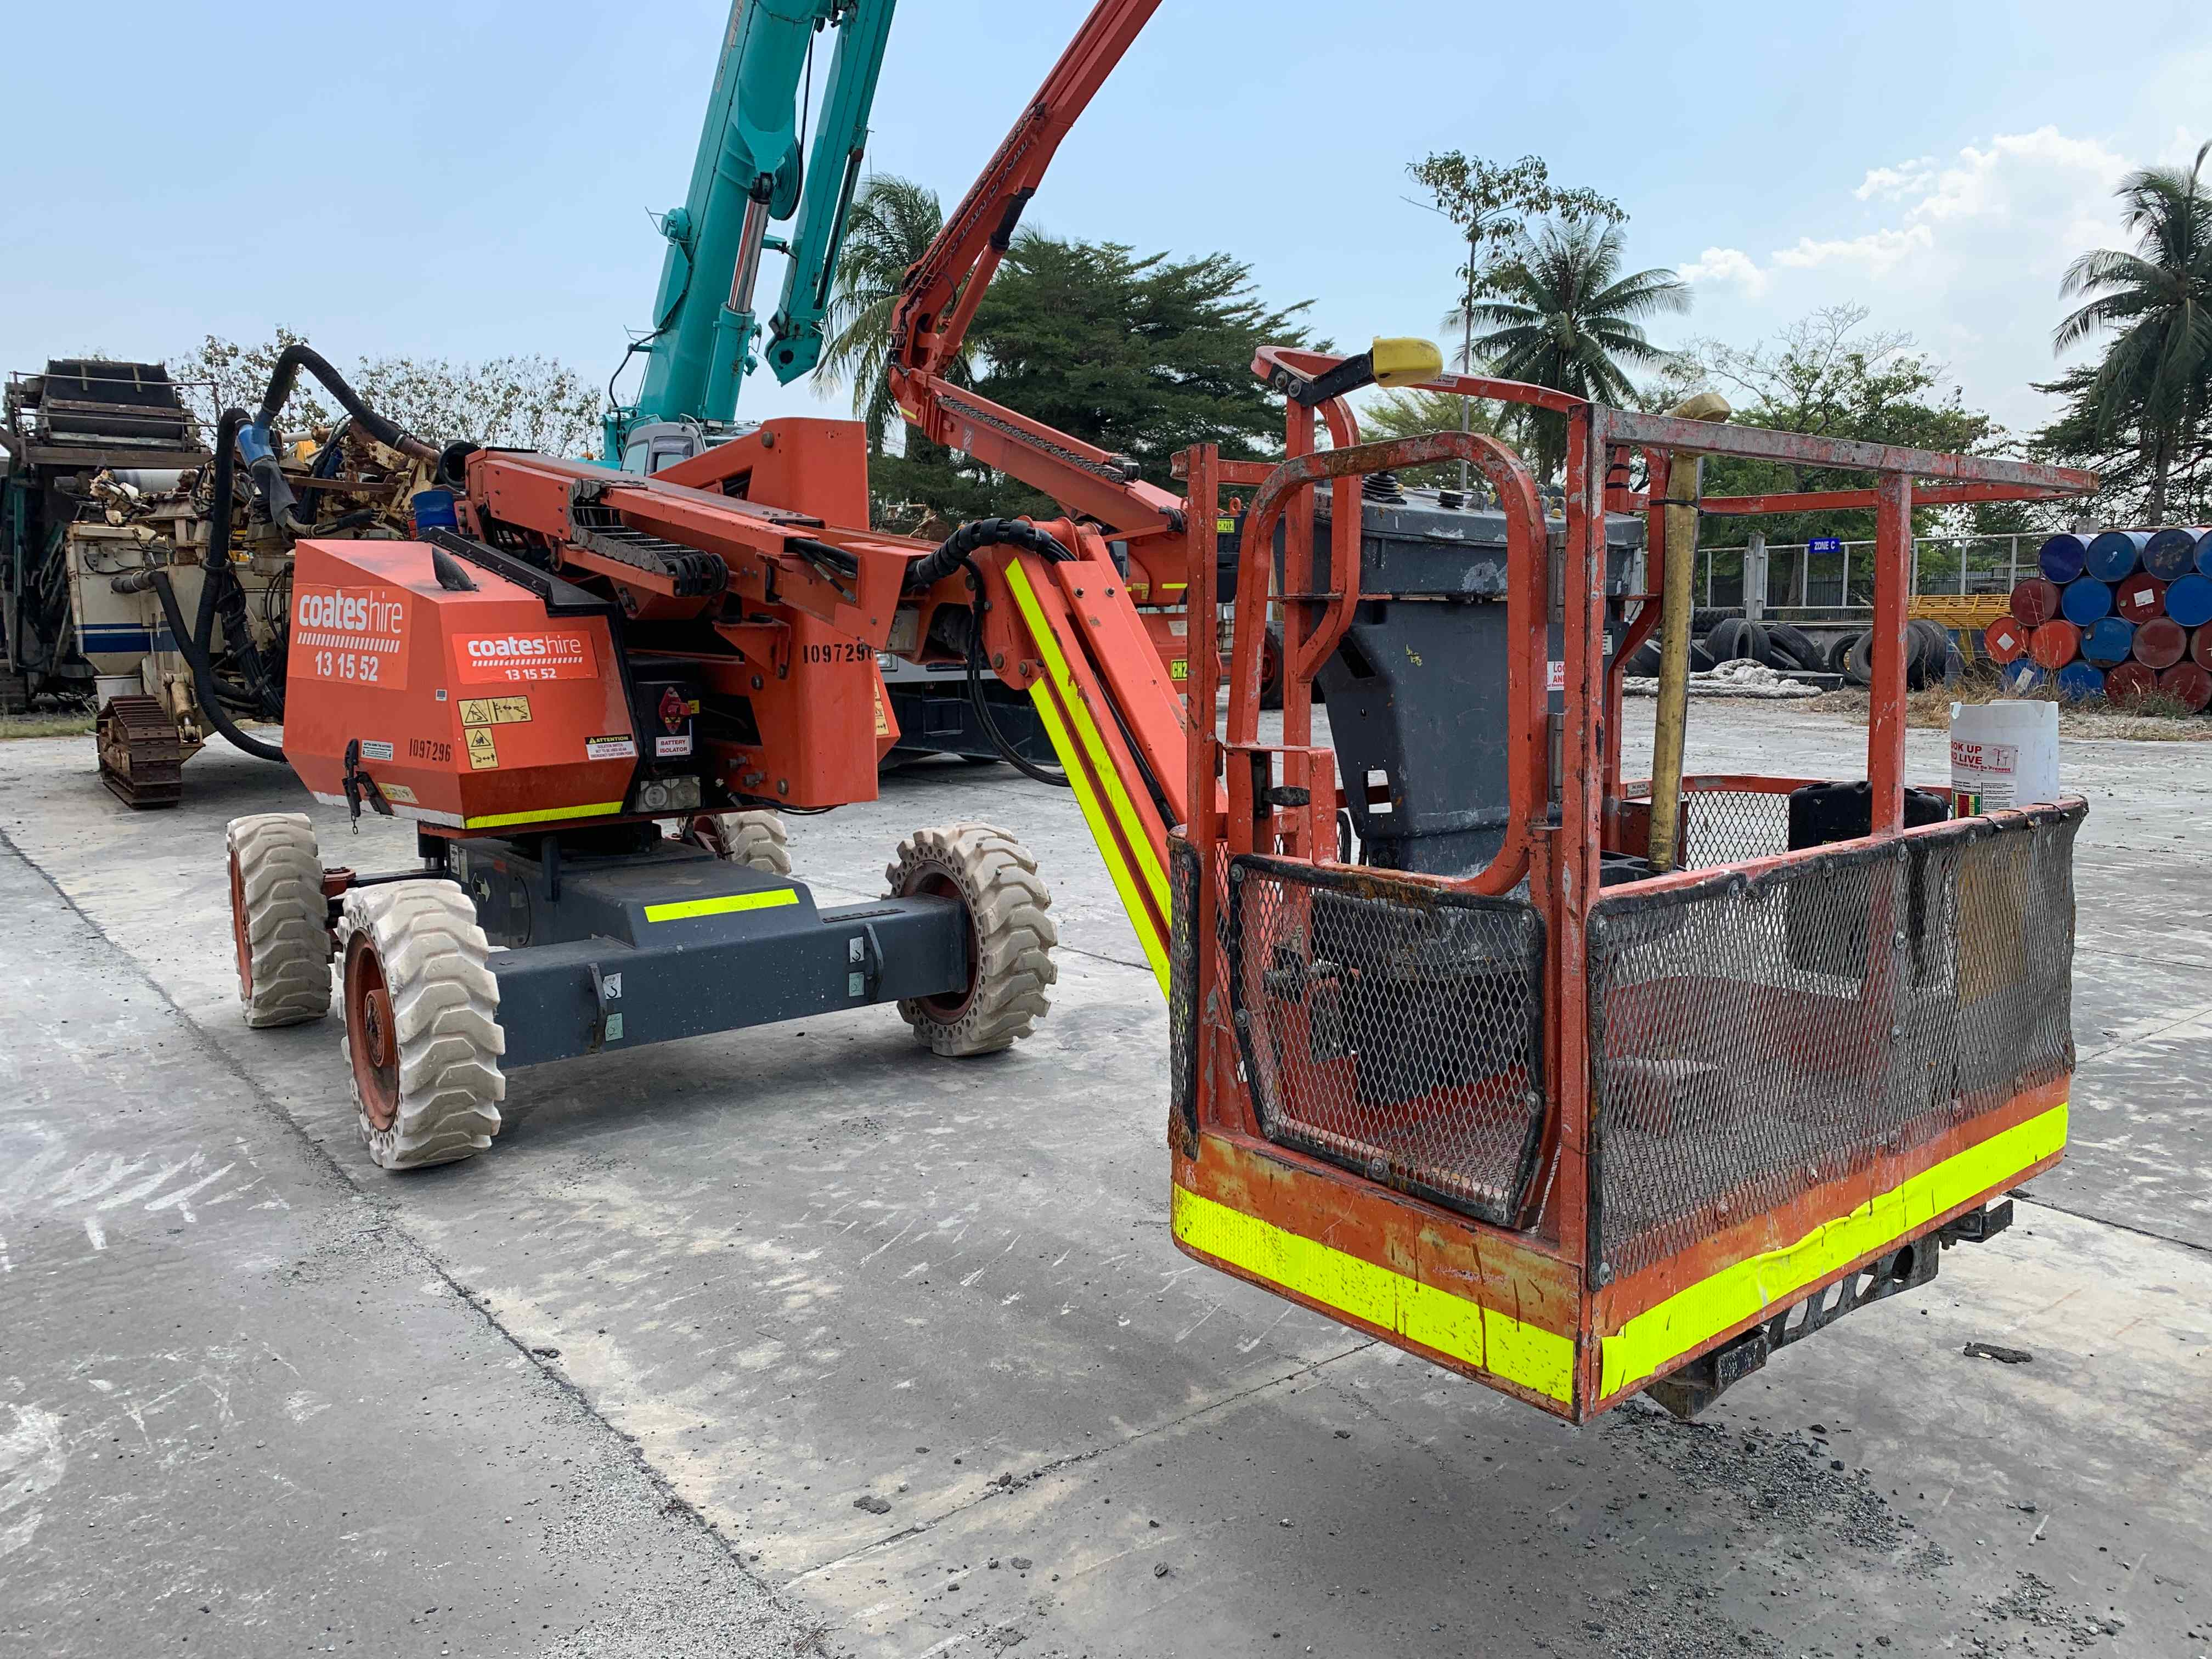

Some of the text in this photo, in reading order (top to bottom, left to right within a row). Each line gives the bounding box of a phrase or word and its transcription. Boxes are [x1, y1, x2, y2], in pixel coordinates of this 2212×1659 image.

[1814, 540, 1835, 550] ZONE C
[315, 651, 379, 681] 13 15 52
[1172, 662, 1187, 678] CH2
[505, 668, 557, 680] 13 15 52
[1553, 675, 1564, 683] AN
[409, 738, 451, 762] 1097296
[1967, 745, 1982, 754] UP
[1959, 754, 1983, 765] LIVE
